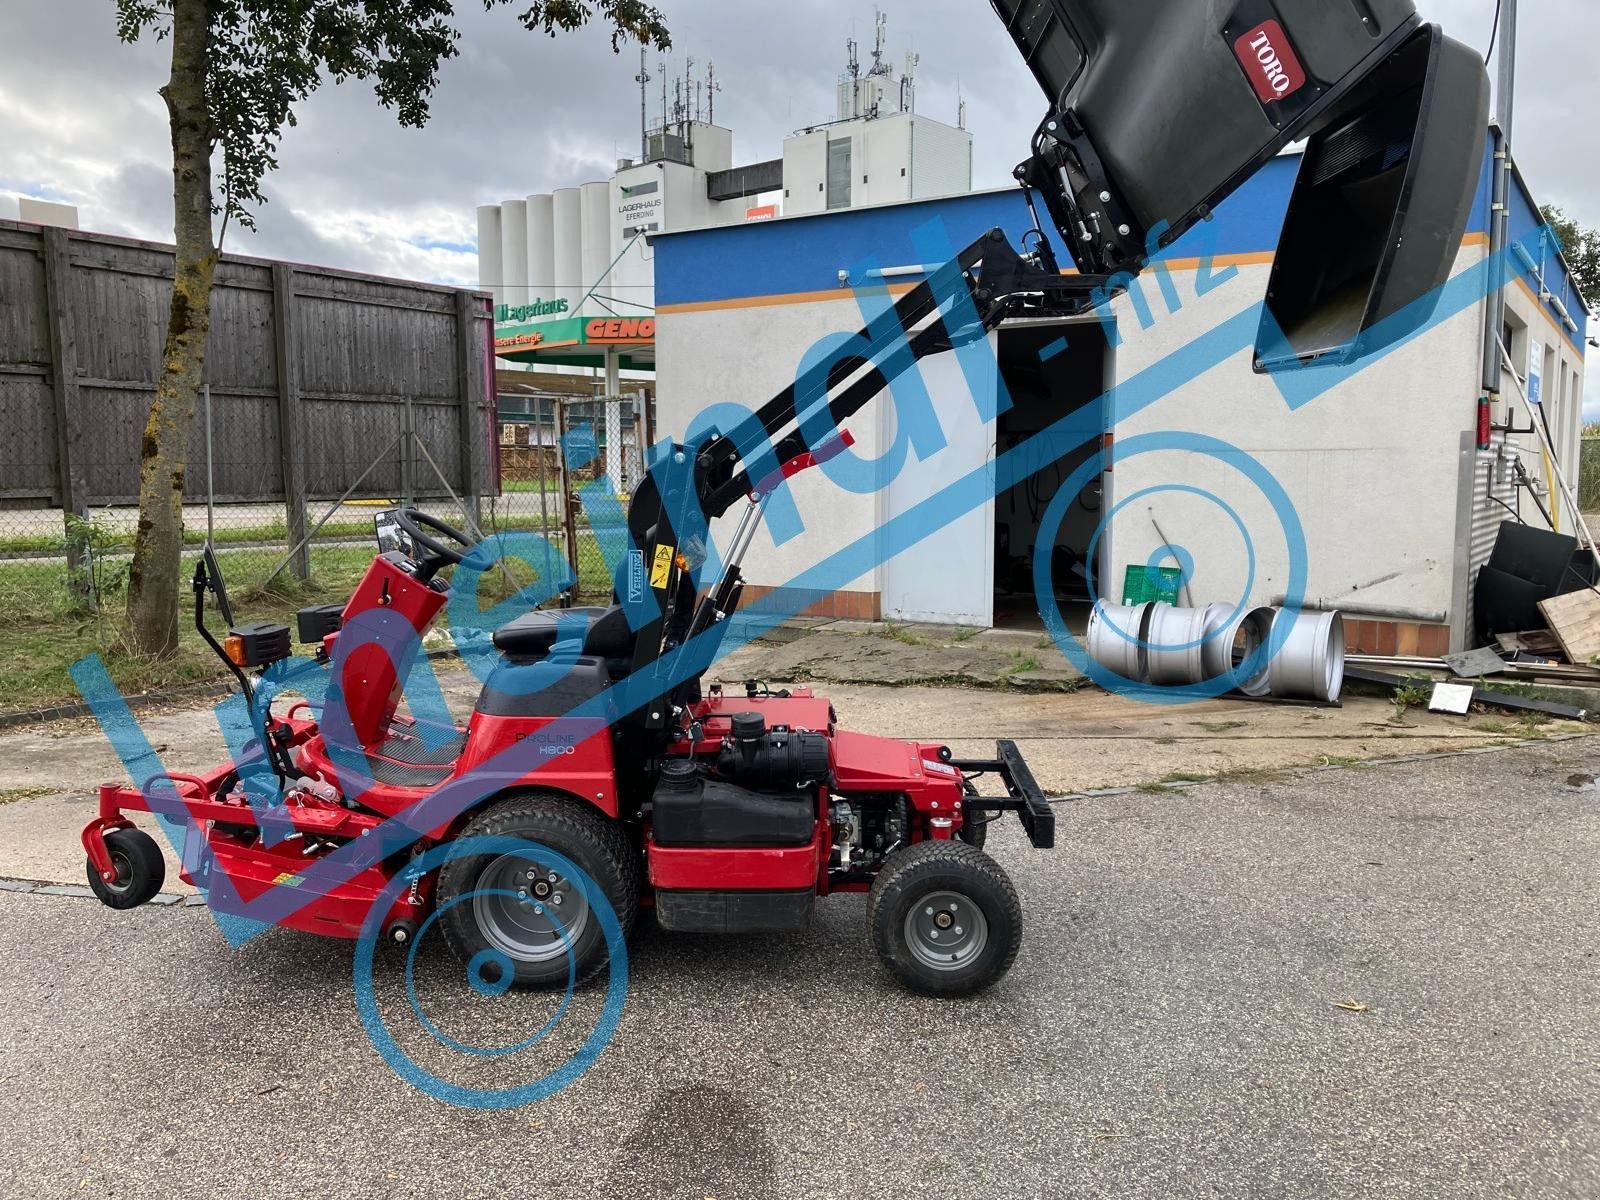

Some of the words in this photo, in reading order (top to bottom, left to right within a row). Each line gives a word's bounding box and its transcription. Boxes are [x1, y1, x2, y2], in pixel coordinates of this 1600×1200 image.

[1249, 30, 1290, 92] TORO
[618, 198, 661, 213] LAGERHAUS
[626, 209, 654, 221] EFERDING
[630, 553, 642, 599] VEHLING
[539, 745, 575, 755] H800
